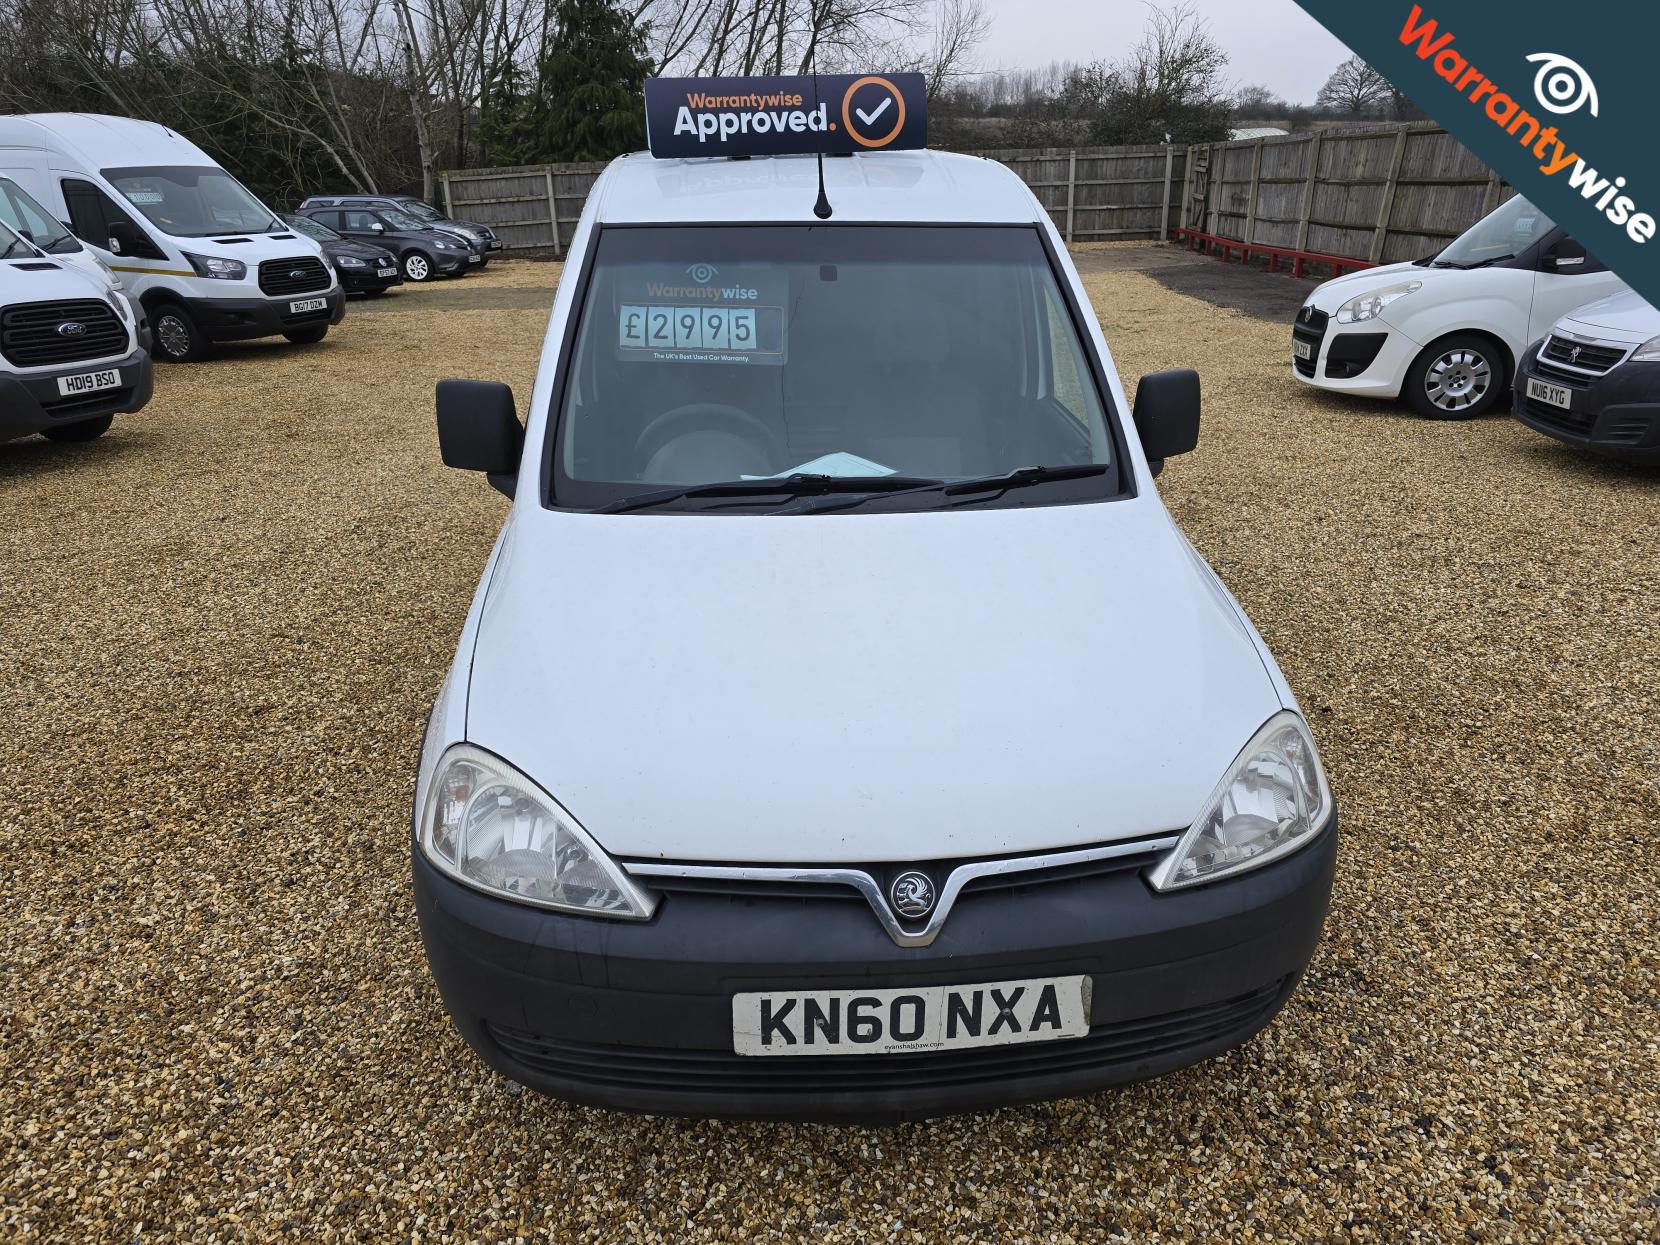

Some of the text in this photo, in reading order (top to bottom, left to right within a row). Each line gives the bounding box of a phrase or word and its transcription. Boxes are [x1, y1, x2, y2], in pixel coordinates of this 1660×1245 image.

[687, 91, 803, 111] Warrantywise
[673, 103, 837, 142] Approved.
[646, 282, 758, 302] Warrantywise
[625, 313, 750, 341] £2995
[66, 375, 94, 392] HD19
[1531, 382, 1566, 405] NU16 XYG
[760, 984, 1062, 1045] KN60 NXA
